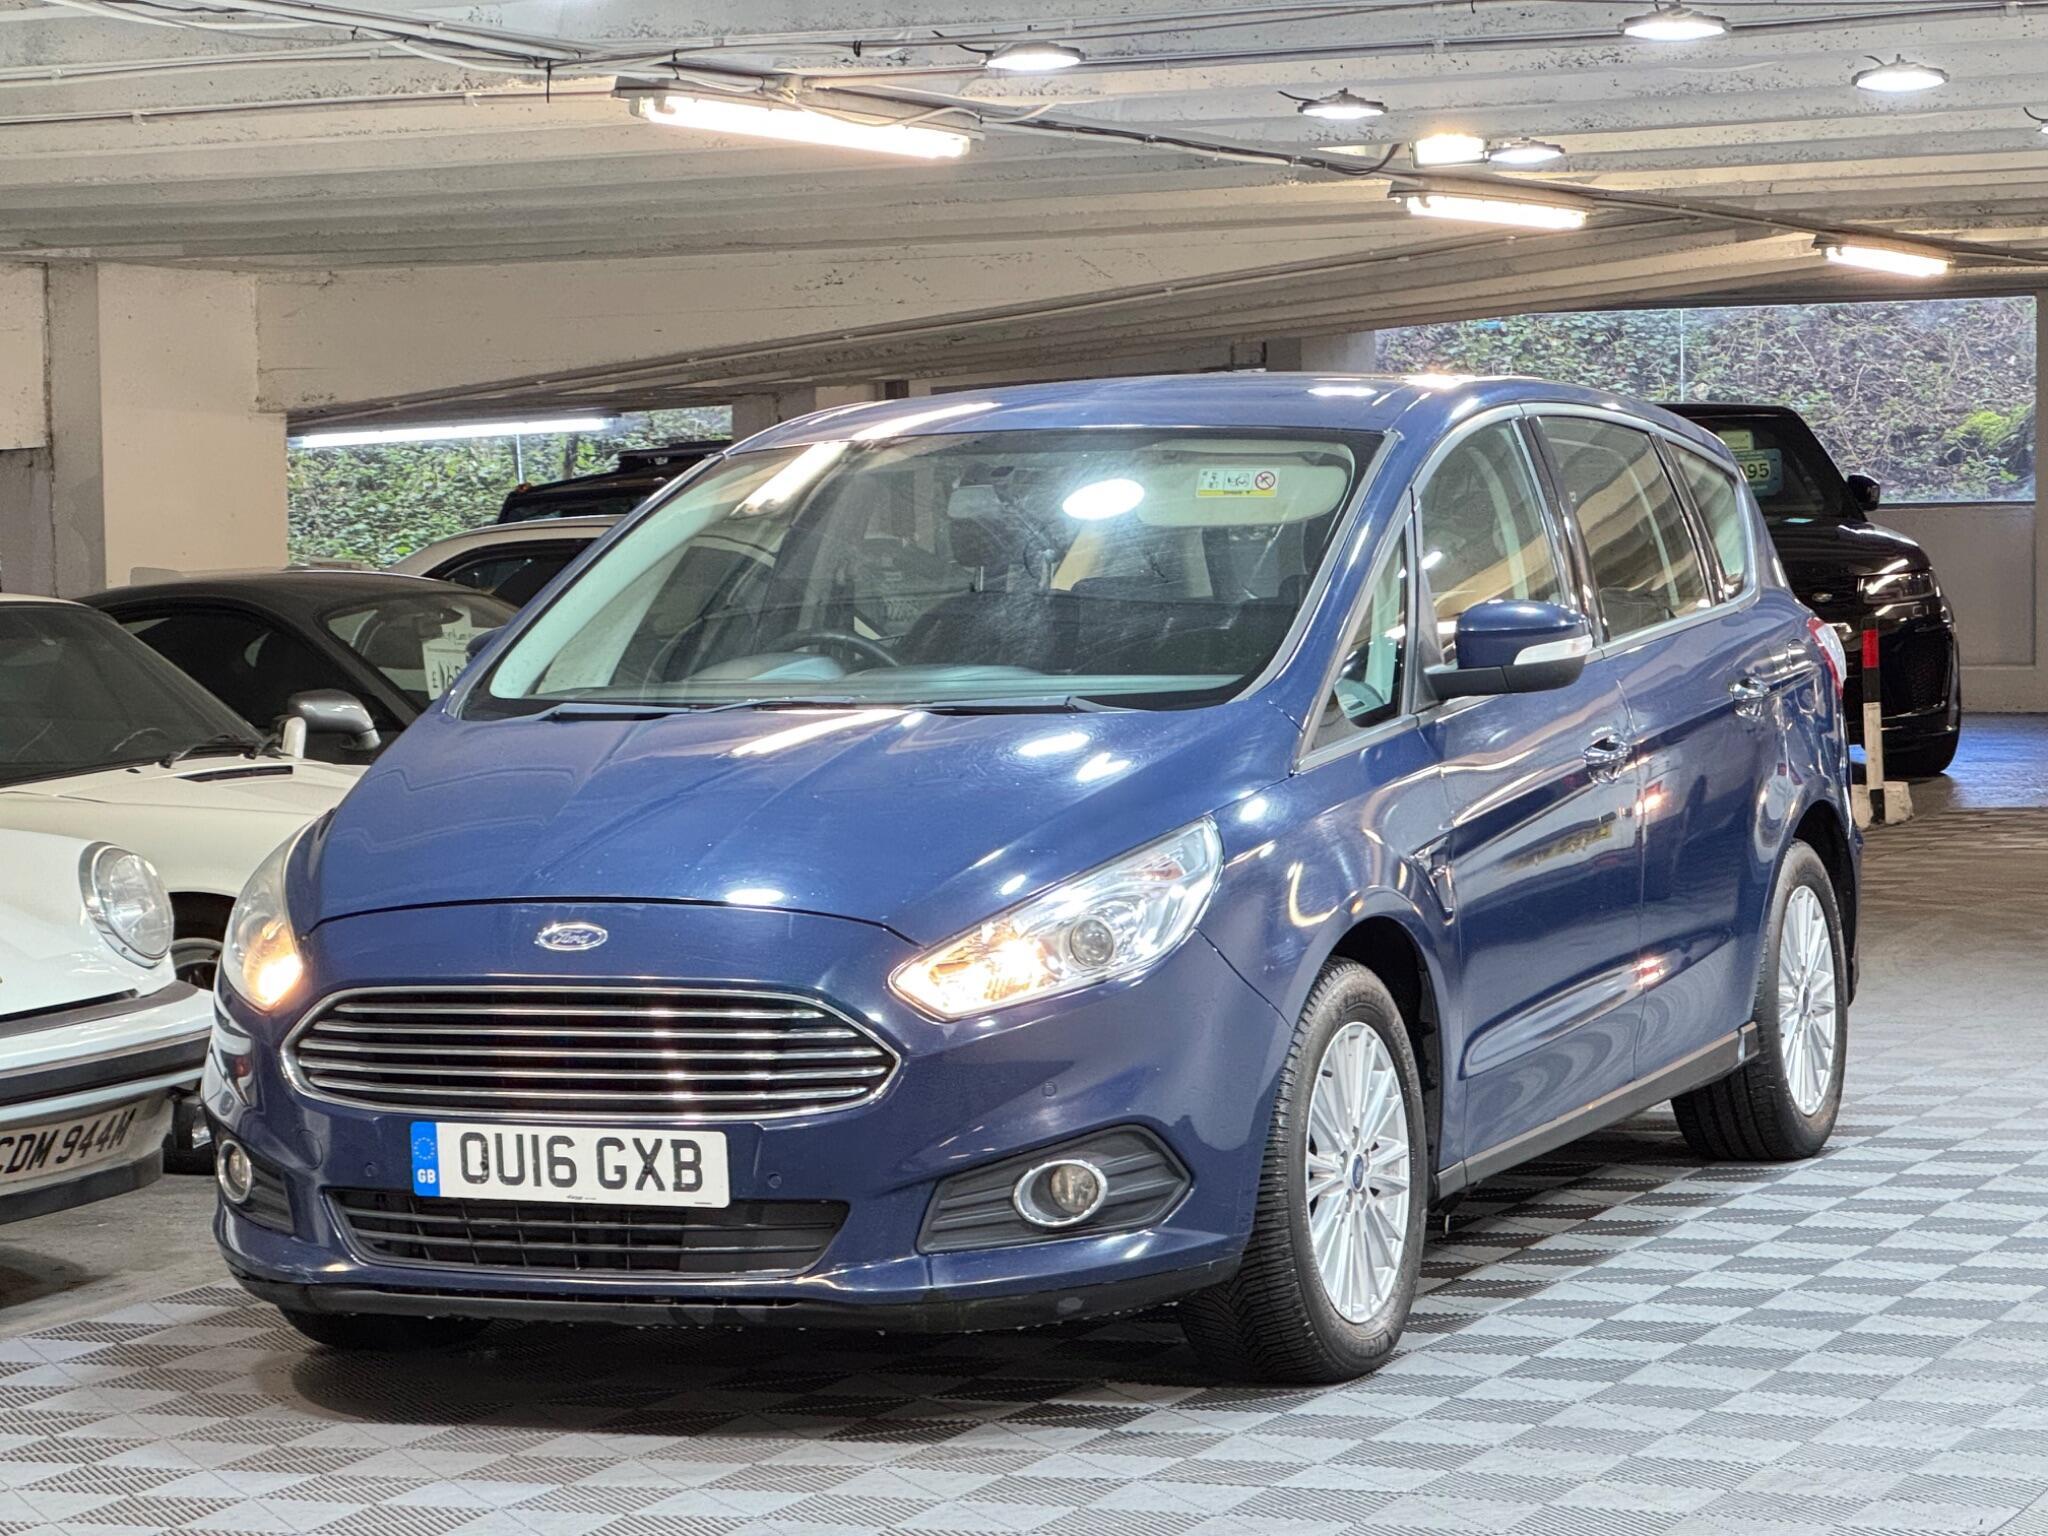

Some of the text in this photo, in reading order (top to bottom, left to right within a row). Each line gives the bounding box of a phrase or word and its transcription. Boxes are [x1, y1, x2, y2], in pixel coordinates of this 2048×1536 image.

[549, 927, 593, 945] Ford
[55, 1108, 137, 1164] 944M
[417, 1168, 436, 1184] GB
[459, 1131, 704, 1193] OU16 GXB
